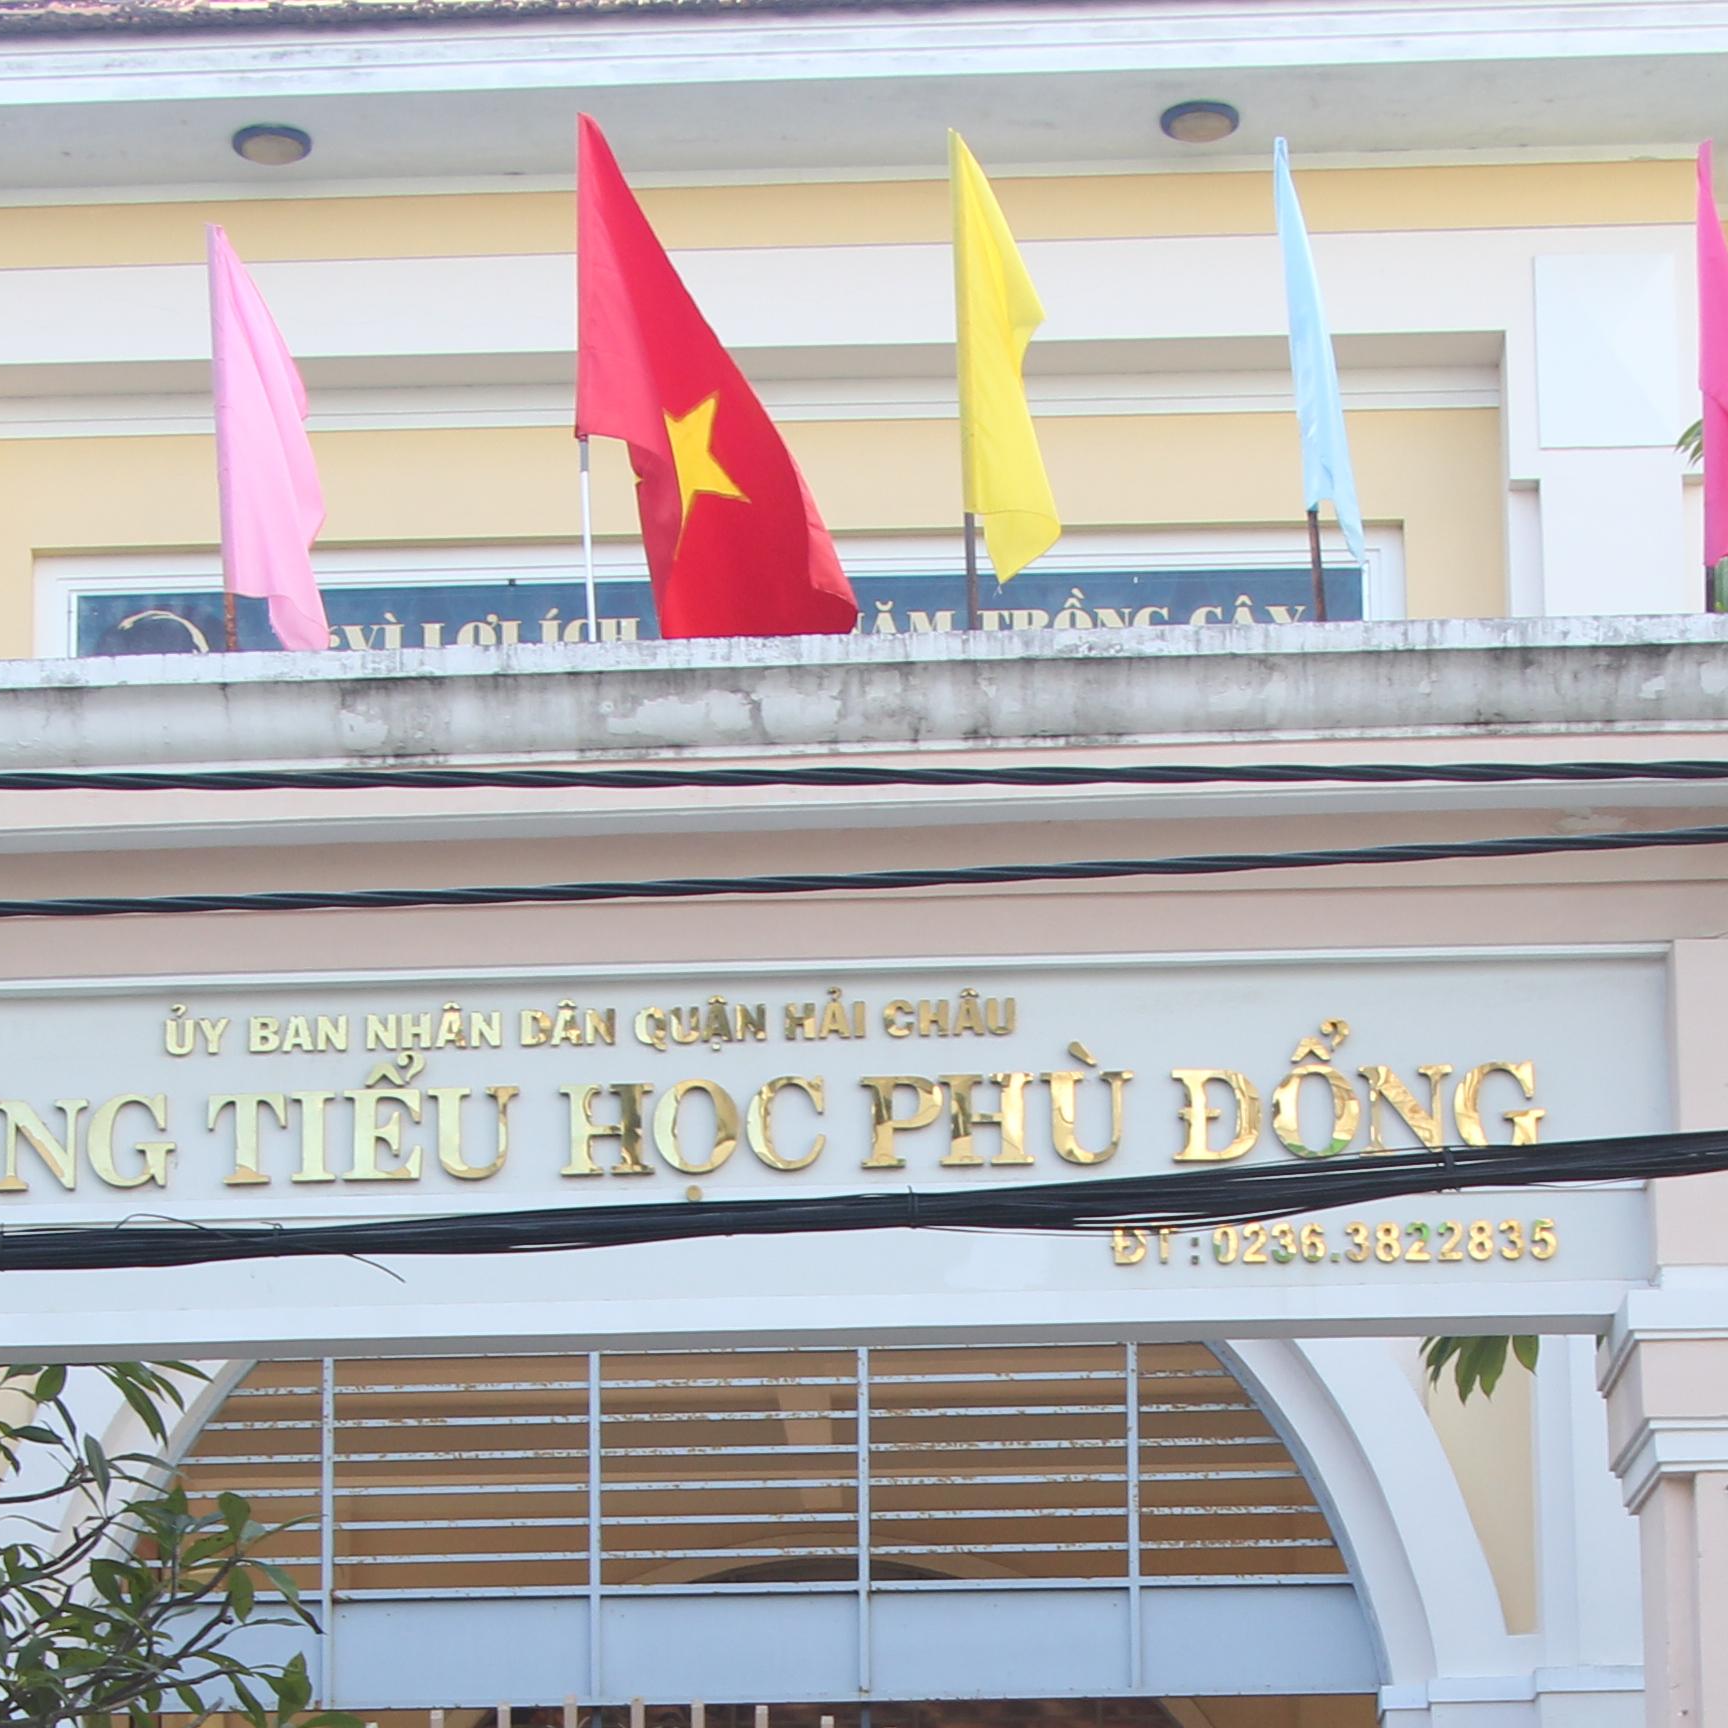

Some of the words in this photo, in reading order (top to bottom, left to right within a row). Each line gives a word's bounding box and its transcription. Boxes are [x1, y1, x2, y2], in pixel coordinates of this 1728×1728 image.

[164, 1003, 230, 1057] ỦY
[248, 1014, 349, 1054] BAN
[366, 1001, 503, 1052] NHÂN
[520, 998, 616, 1047] DÂN
[633, 994, 767, 1052] QUẬN
[784, 986, 867, 1042] HẢI
[882, 986, 1016, 1039] CHÂU
[207, 1051, 521, 1188] TIỂU
[558, 1073, 826, 1202] HỌC
[859, 1040, 1134, 1171] PHÙ
[1171, 1017, 1547, 1163] ĐỔNG
